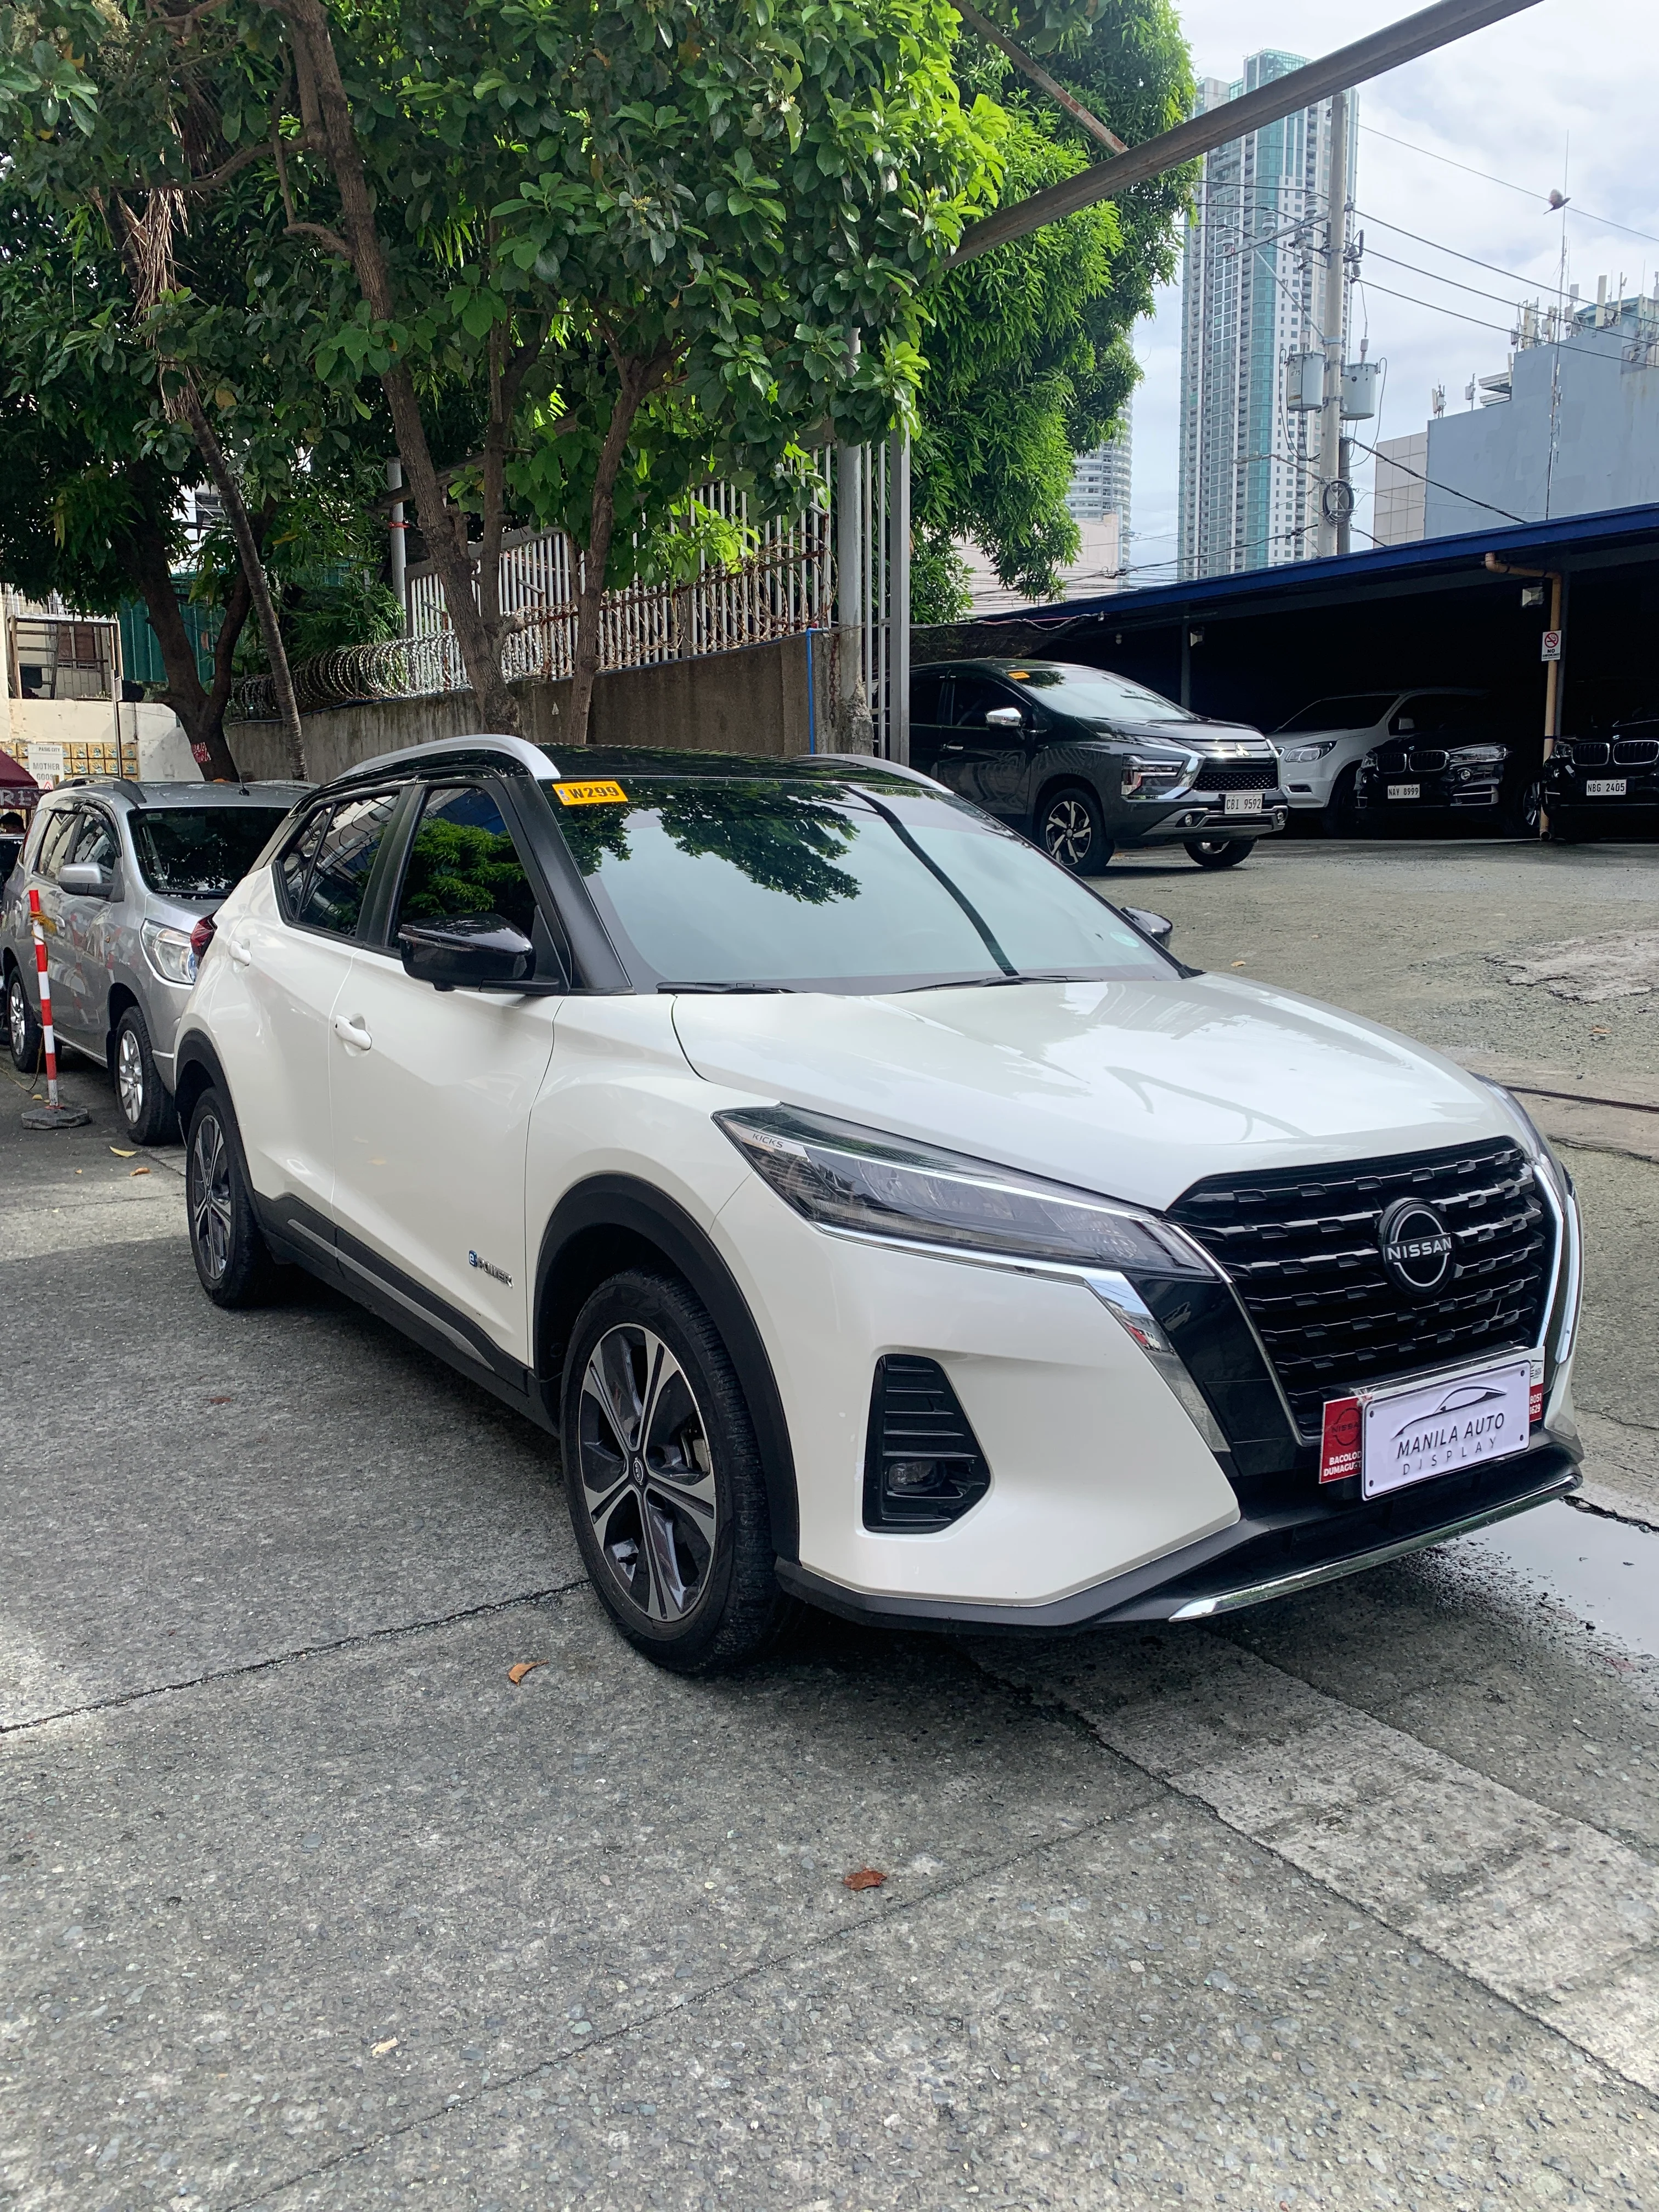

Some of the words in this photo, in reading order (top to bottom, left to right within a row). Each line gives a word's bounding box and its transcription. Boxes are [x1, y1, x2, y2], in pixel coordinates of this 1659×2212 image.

[568, 786, 619, 799] W299
[1403, 787, 1419, 795] 8999
[1588, 783, 1601, 792] NBG
[1606, 783, 1625, 792] 2405
[1226, 799, 1239, 810] CBI
[1244, 798, 1261, 809] 9592
[752, 1133, 784, 1148] KICKS
[1387, 1237, 1452, 1260] NISSAN
[1331, 1422, 1361, 1432] NISSA
[1397, 1425, 1458, 1459] MANILA
[1463, 1413, 1504, 1439] AUTO
[1329, 1451, 1362, 1466] BACOLOD
[1403, 1436, 1496, 1475] DISPLAY
